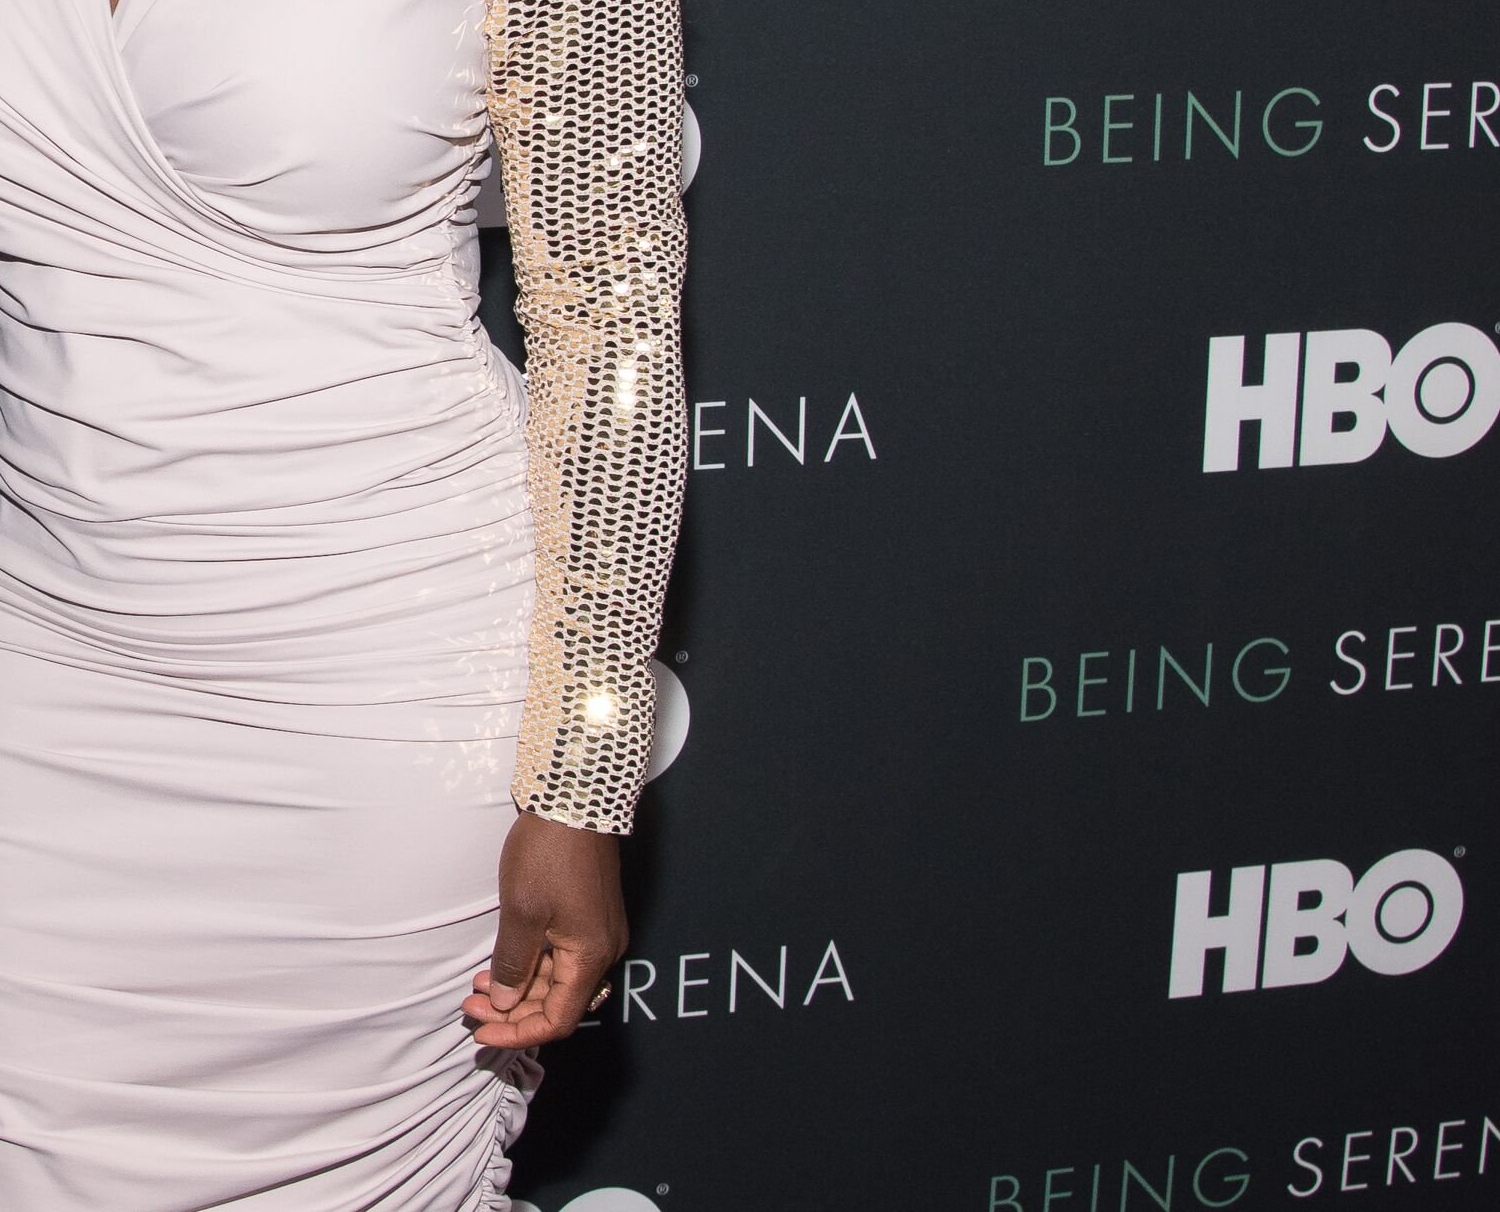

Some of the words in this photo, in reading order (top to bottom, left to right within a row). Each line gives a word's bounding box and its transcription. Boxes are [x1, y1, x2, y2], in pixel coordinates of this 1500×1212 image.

[1043, 86, 1324, 166] BEING
[1362, 80, 1500, 154] SER
[1202, 321, 1500, 474] HBO
[1020, 637, 1291, 722] BEING
[1167, 848, 1464, 1000] HBO
[578, 939, 855, 1027] RENA
